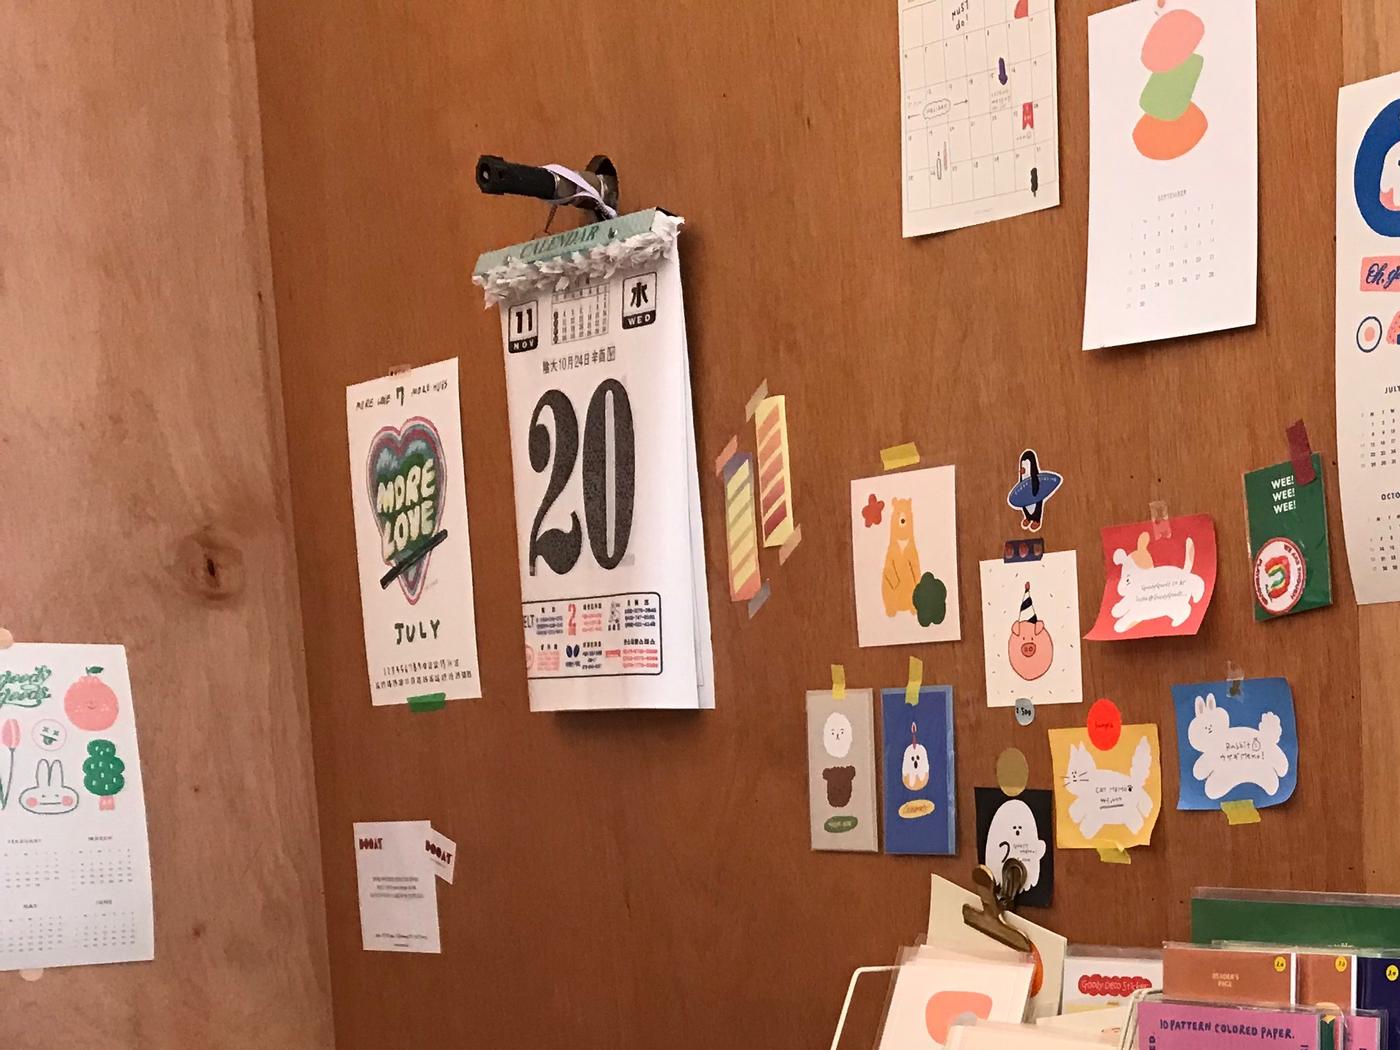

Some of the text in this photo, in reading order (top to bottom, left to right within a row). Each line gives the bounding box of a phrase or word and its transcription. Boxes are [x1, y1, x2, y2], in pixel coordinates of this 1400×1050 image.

[520, 225, 600, 257] CALENDAR
[630, 281, 648, 308] 水
[515, 308, 532, 334] 11
[627, 314, 651, 326] WED
[513, 338, 534, 350] NOV
[376, 458, 436, 514] MORE
[528, 378, 635, 576] 20
[1270, 475, 1294, 490] WEE!
[1272, 487, 1296, 502] WEE!
[1273, 500, 1297, 514] WEE!
[382, 500, 435, 562] LOVE
[394, 618, 441, 645] JULY
[1170, 1019, 1212, 1032] PATTERN
[1214, 1023, 1258, 1037] COLORED
[1261, 1027, 1295, 1040] PAPER.
